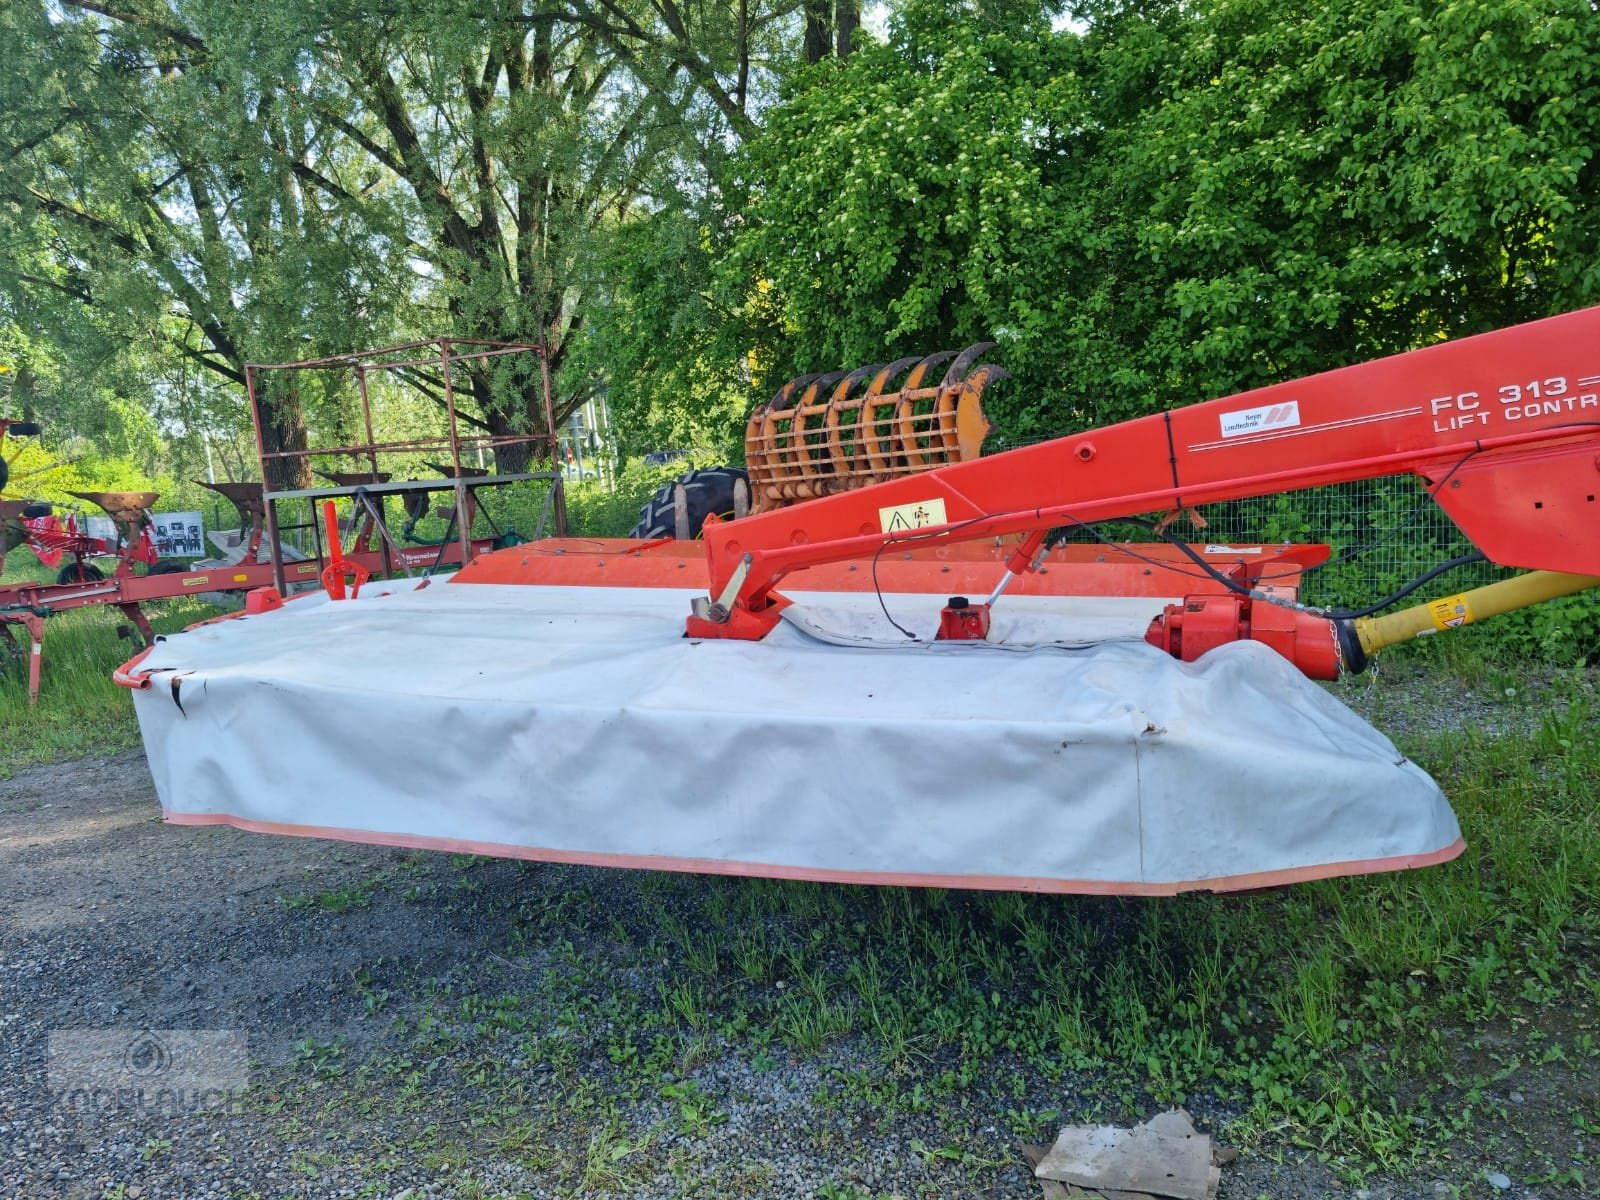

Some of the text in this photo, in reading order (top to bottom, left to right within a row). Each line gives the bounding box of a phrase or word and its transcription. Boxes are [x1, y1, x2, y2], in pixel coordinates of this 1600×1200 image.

[1431, 376, 1568, 416] FC 313
[1433, 393, 1599, 433] LIFT CONTR
